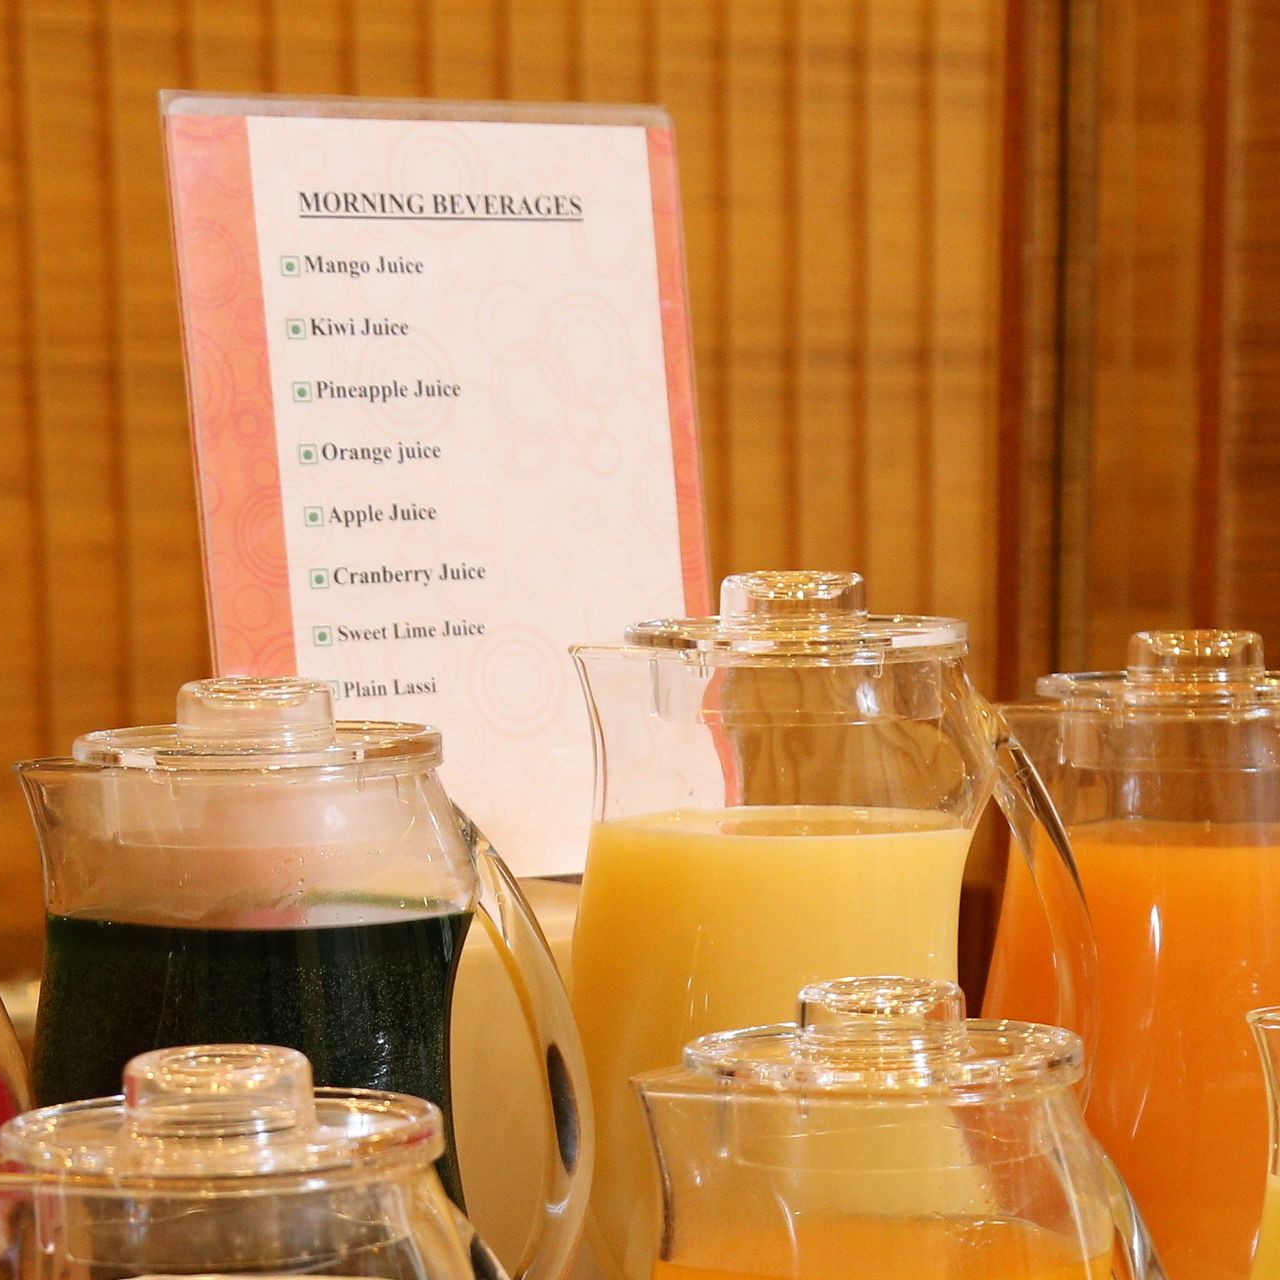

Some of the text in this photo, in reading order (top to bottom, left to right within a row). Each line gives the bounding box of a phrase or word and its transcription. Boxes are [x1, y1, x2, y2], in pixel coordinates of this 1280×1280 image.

[299, 191, 583, 216] MORNING BEVERAGES
[304, 255, 424, 279] Mango Juice
[310, 317, 409, 337] Kiwi Juice
[316, 379, 461, 404] Pineapple Juice
[321, 441, 441, 465] Orange juice
[328, 503, 437, 528] Apple Juice
[333, 562, 486, 587] Cranberry Juice
[337, 619, 485, 641] Sweet Lime Juice
[343, 676, 437, 698] Plain Lassi
